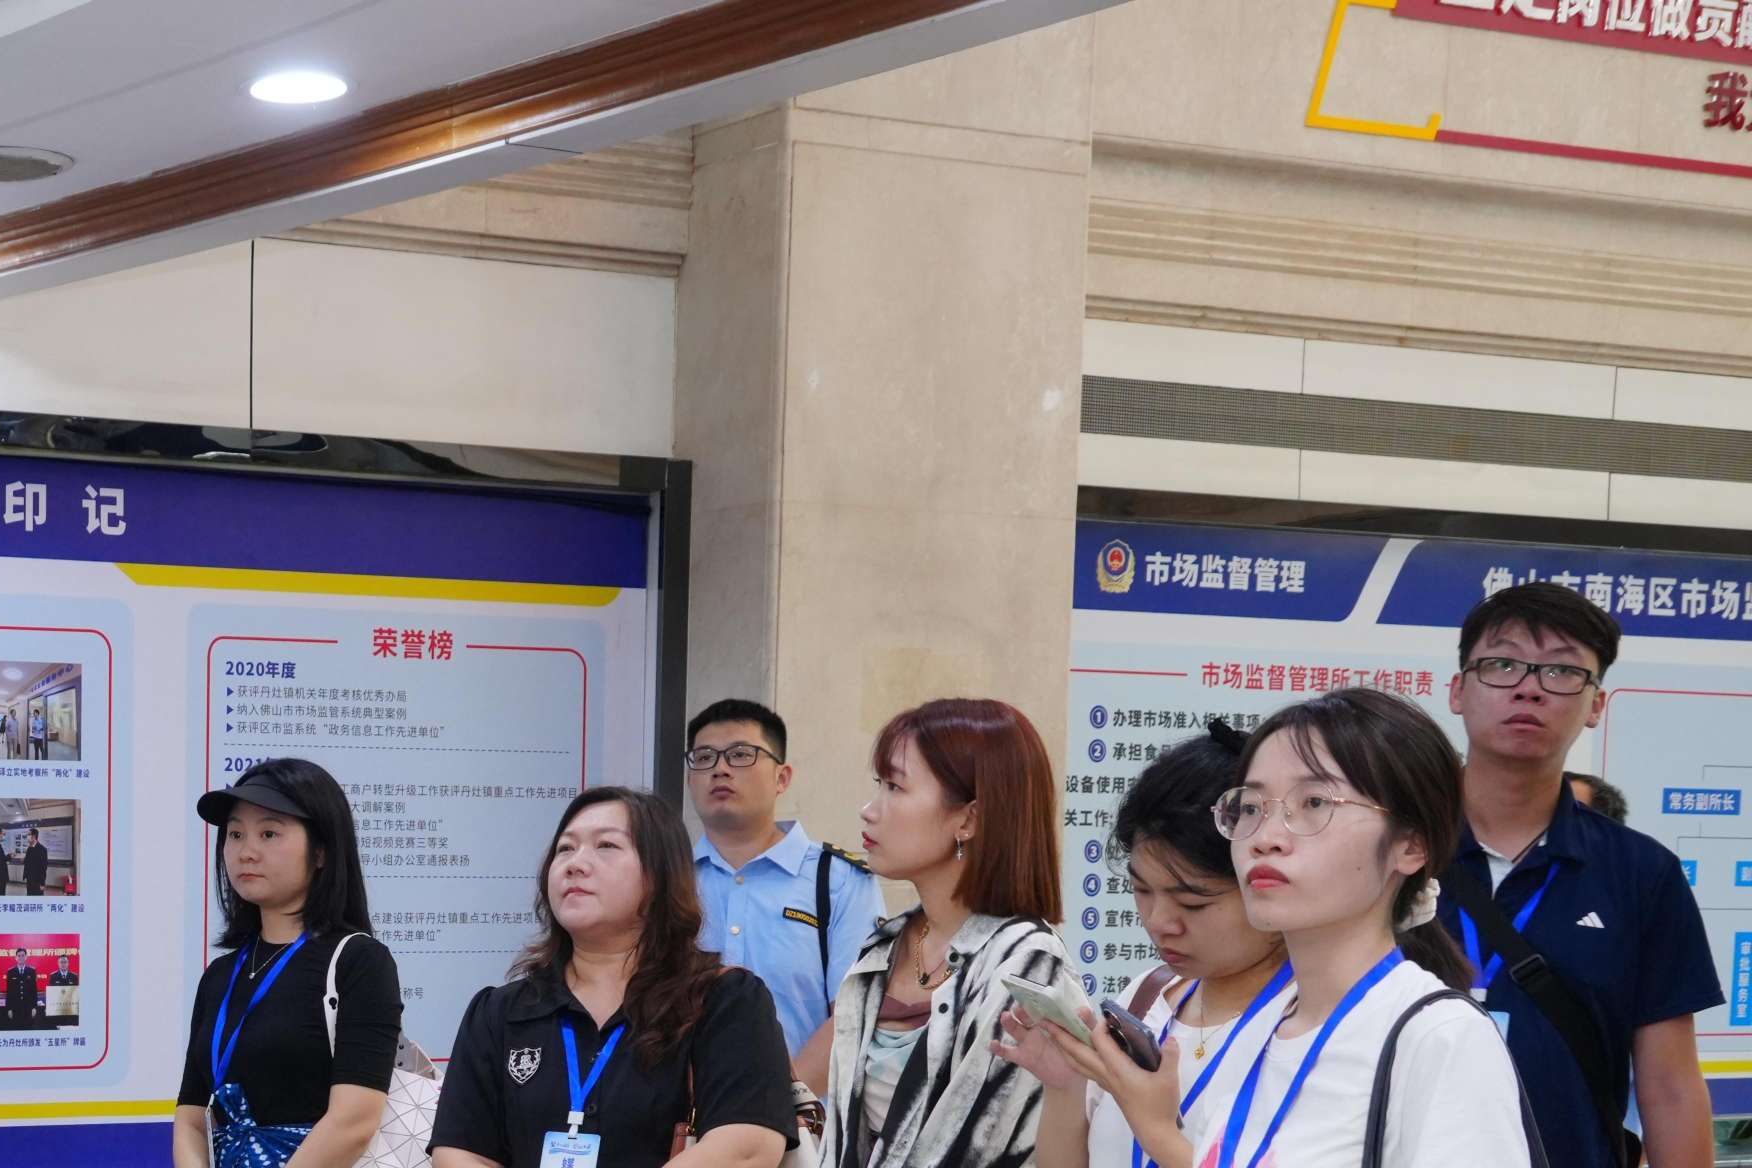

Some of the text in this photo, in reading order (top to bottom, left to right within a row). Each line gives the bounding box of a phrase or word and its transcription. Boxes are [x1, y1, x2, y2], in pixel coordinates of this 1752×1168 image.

[1144, 551, 1307, 594] 市场监督管理
[372, 628, 454, 661] 荣誉榜
[225, 660, 297, 680] 2020年度
[1201, 662, 1434, 697] 市场监督管理所工作职责
[237, 703, 408, 721] 纳入佛山市市场监管系统典型案例
[1669, 793, 1735, 811] 常务副所长
[358, 836, 449, 850] 短视频竞赛三等奖
